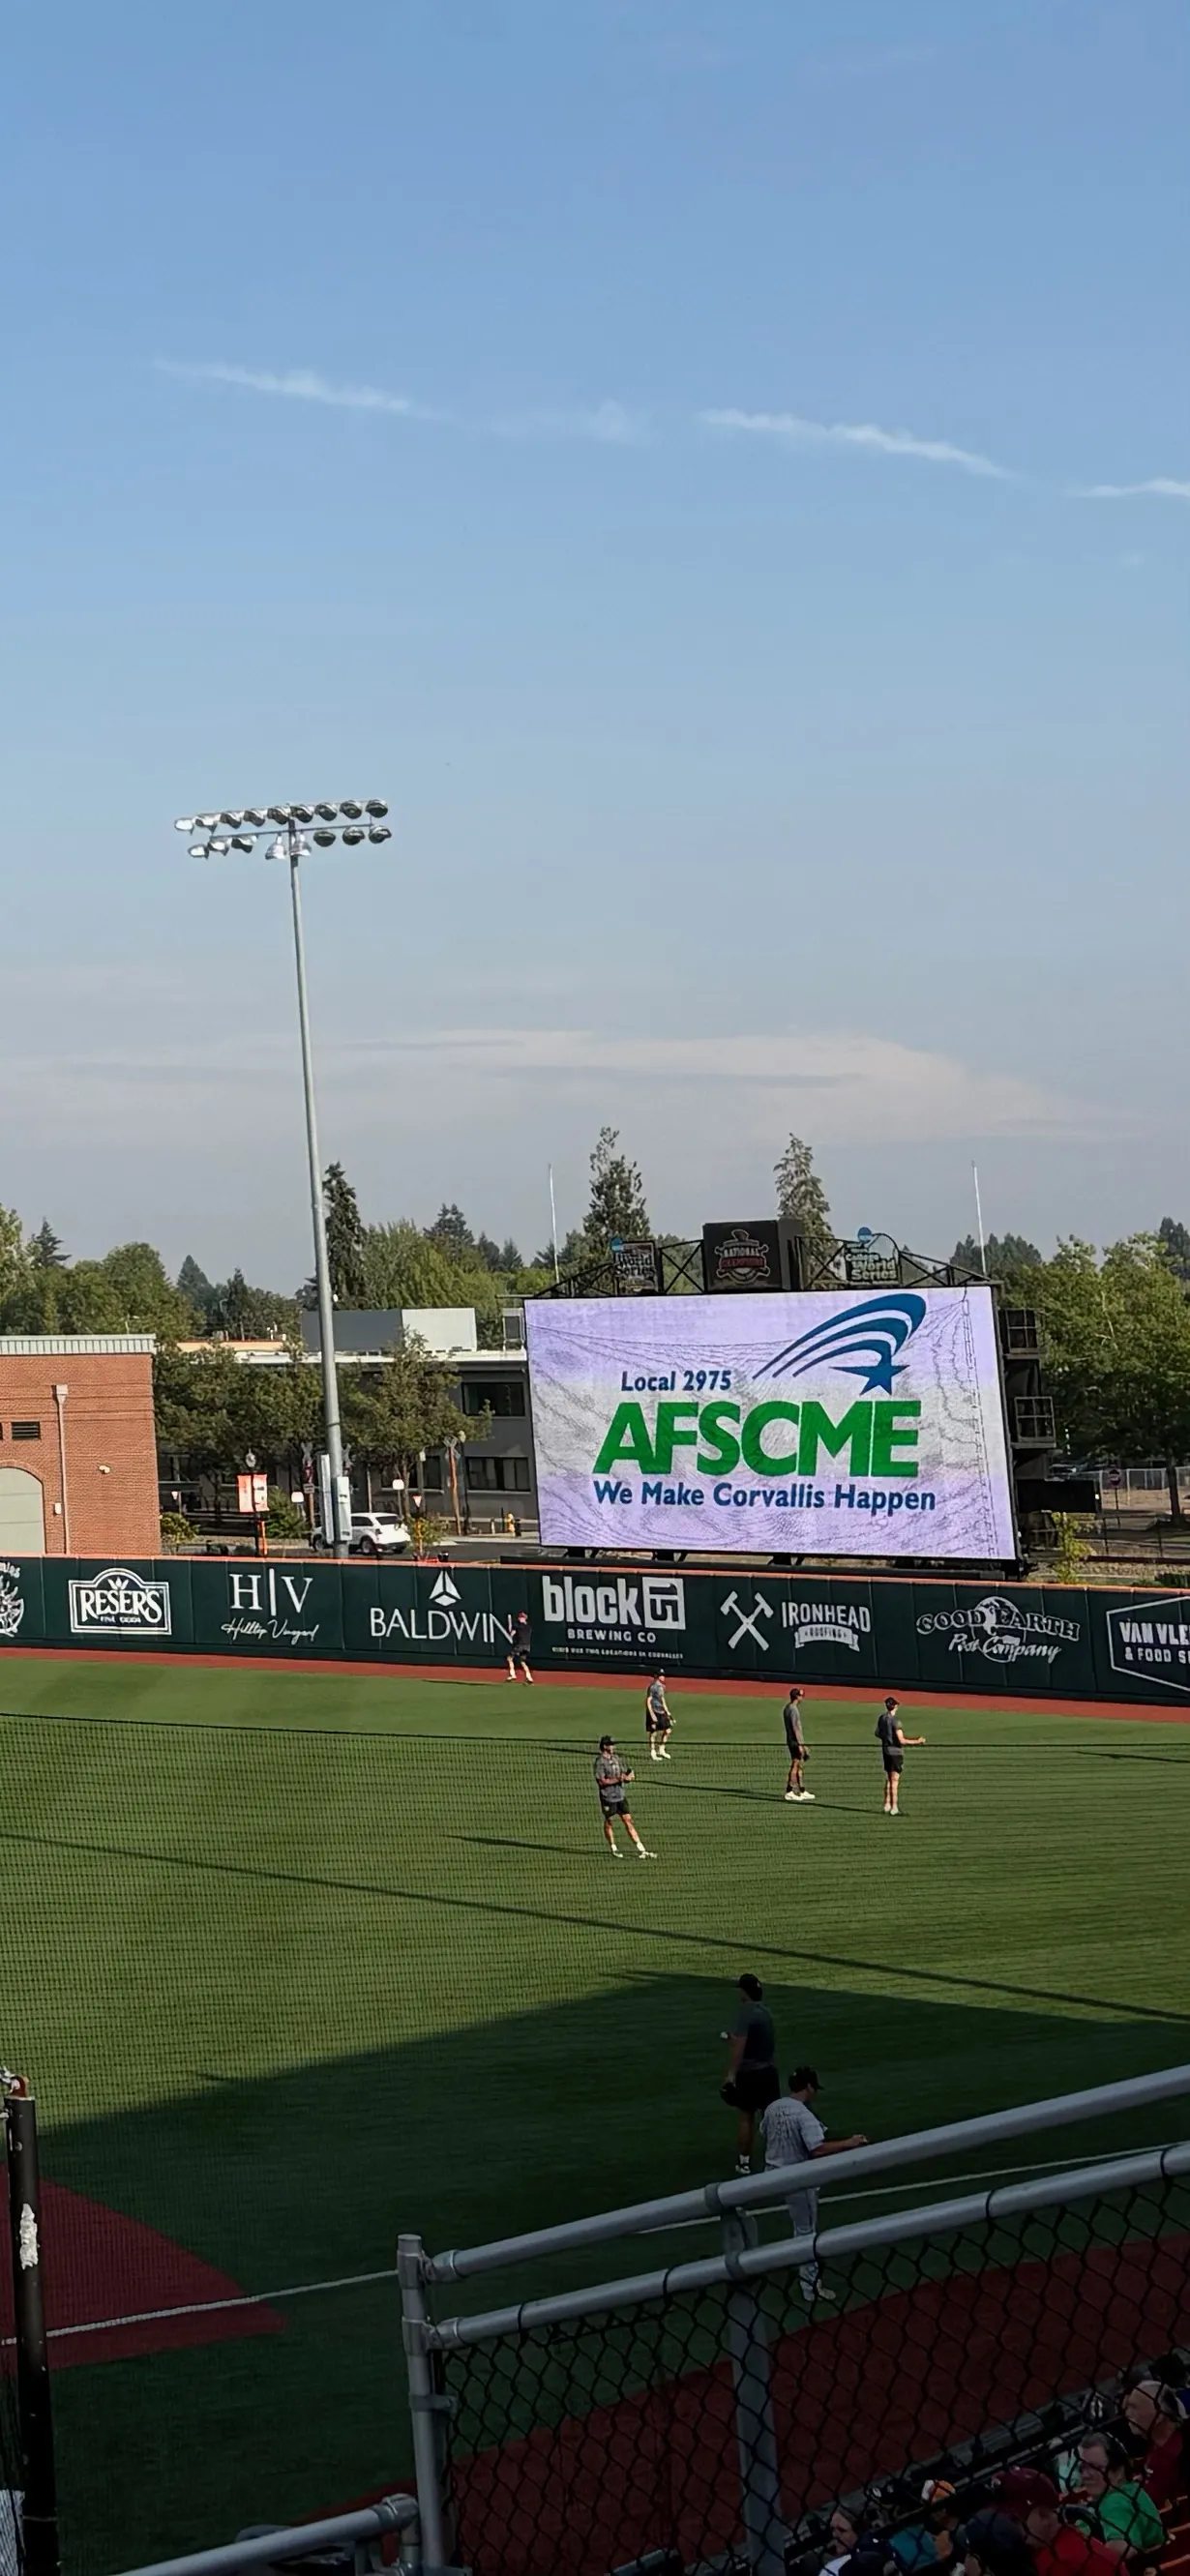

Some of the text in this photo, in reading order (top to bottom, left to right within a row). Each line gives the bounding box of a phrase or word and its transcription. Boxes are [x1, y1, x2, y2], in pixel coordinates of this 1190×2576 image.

[851, 1259, 896, 1271] World
[851, 1269, 897, 1280] Series
[621, 1370, 731, 1391] Local 2975
[592, 1400, 921, 1477] AFSCME
[593, 1481, 936, 1517] We Make Corvallis Happen
[79, 1589, 163, 1623] RESER'S
[542, 1575, 642, 1626] block
[370, 1607, 514, 1644] BALDWIN
[782, 1601, 871, 1633] IRONHEAD
[916, 1608, 1081, 1642] GOOD EARTH
[567, 1628, 657, 1643] BREWING CO
[1118, 1621, 1190, 1645] VAN VLE
[983, 1635, 1061, 1664] Company
[1124, 1646, 1190, 1665] & FOOD S
